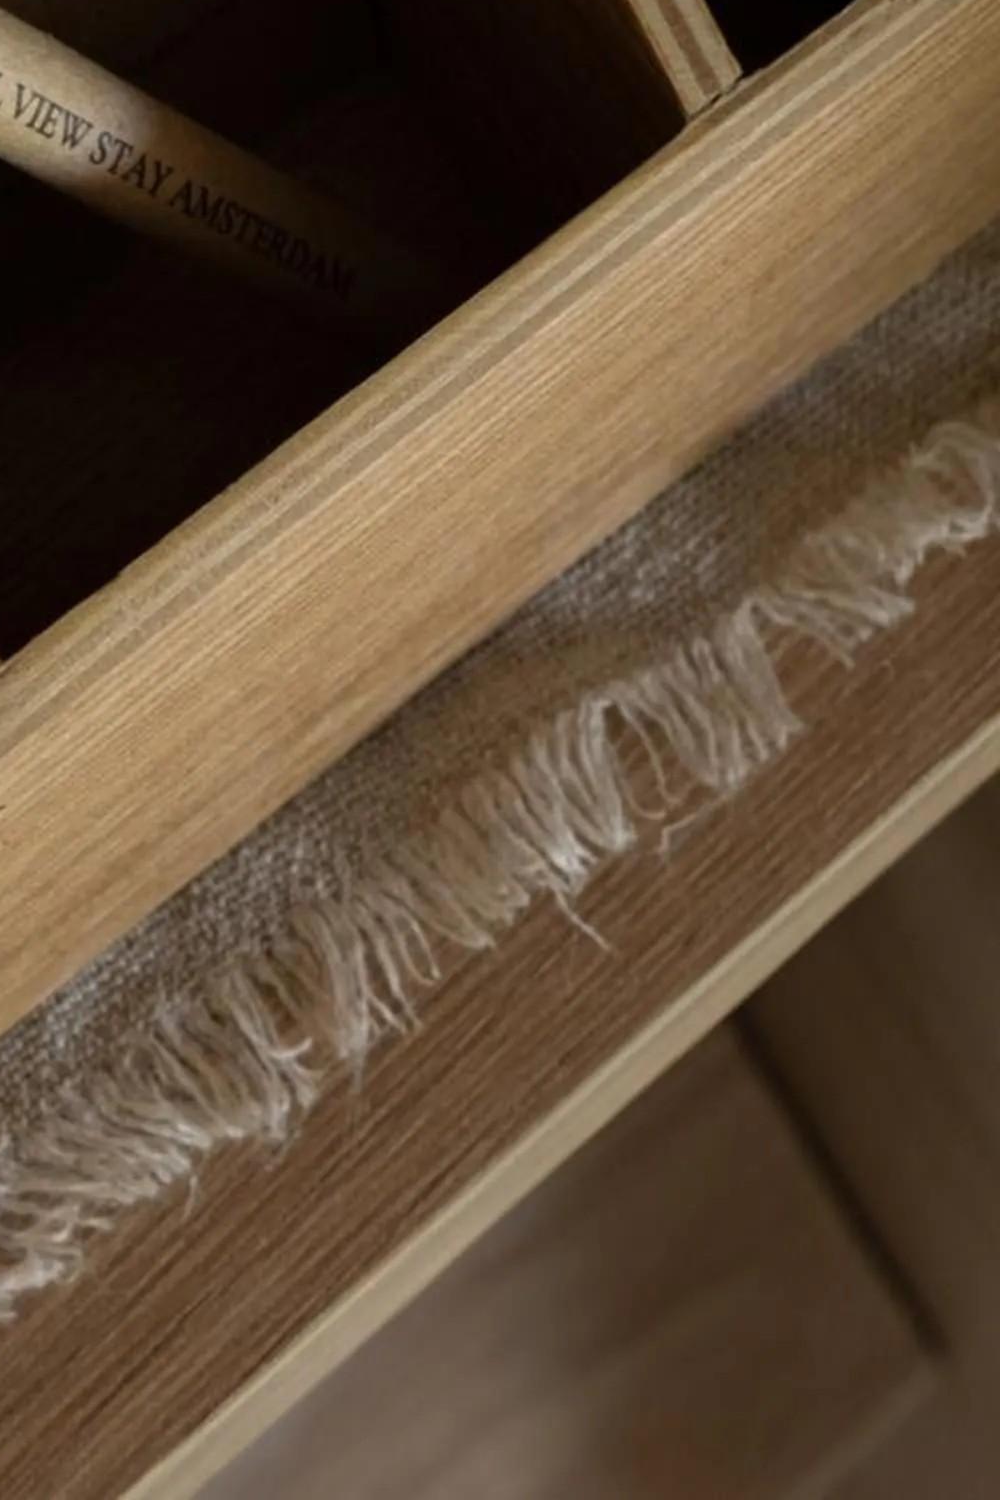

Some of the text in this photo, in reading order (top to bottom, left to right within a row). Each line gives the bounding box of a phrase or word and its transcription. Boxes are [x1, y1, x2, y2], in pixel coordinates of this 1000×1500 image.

[13, 82, 94, 150] VIEW
[89, 130, 174, 198] STAY
[168, 179, 361, 298] AMSTERDAM
